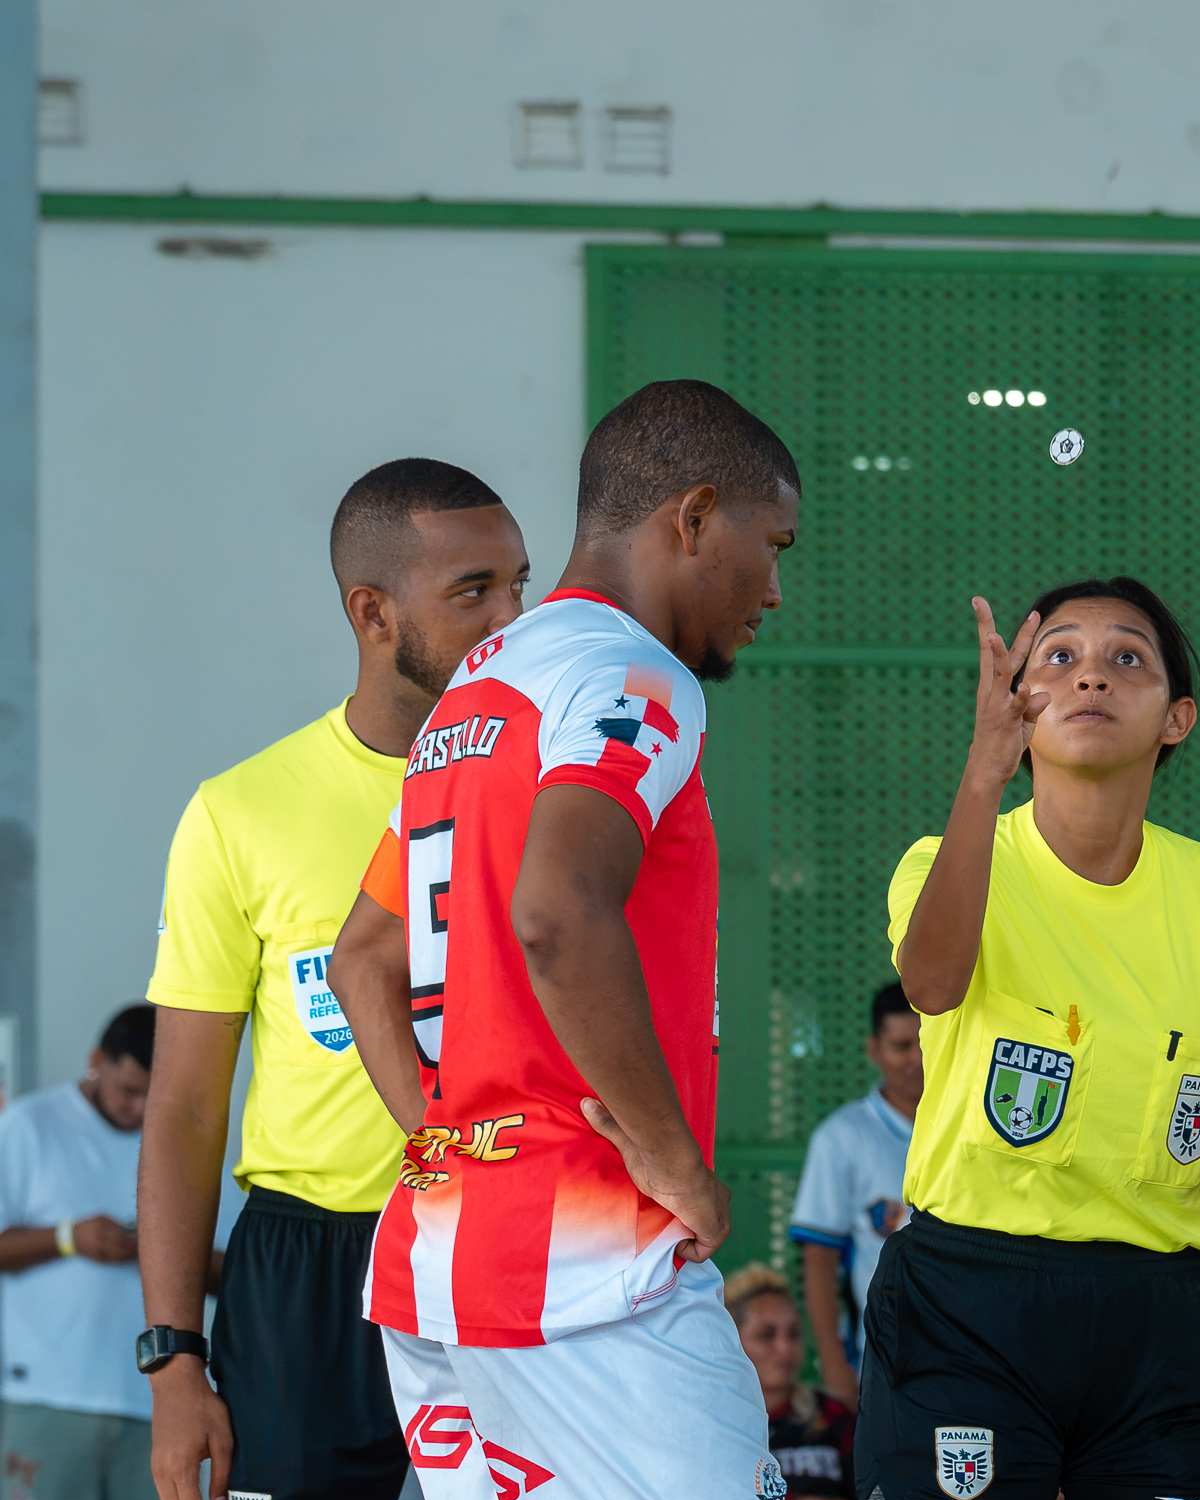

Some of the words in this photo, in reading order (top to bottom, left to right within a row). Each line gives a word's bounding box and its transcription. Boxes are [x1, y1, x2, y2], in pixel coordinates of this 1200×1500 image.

[324, 1029, 353, 1044] 2026
[995, 1041, 1073, 1078] CAFPS
[941, 1430, 988, 1441] PANAMÁ
